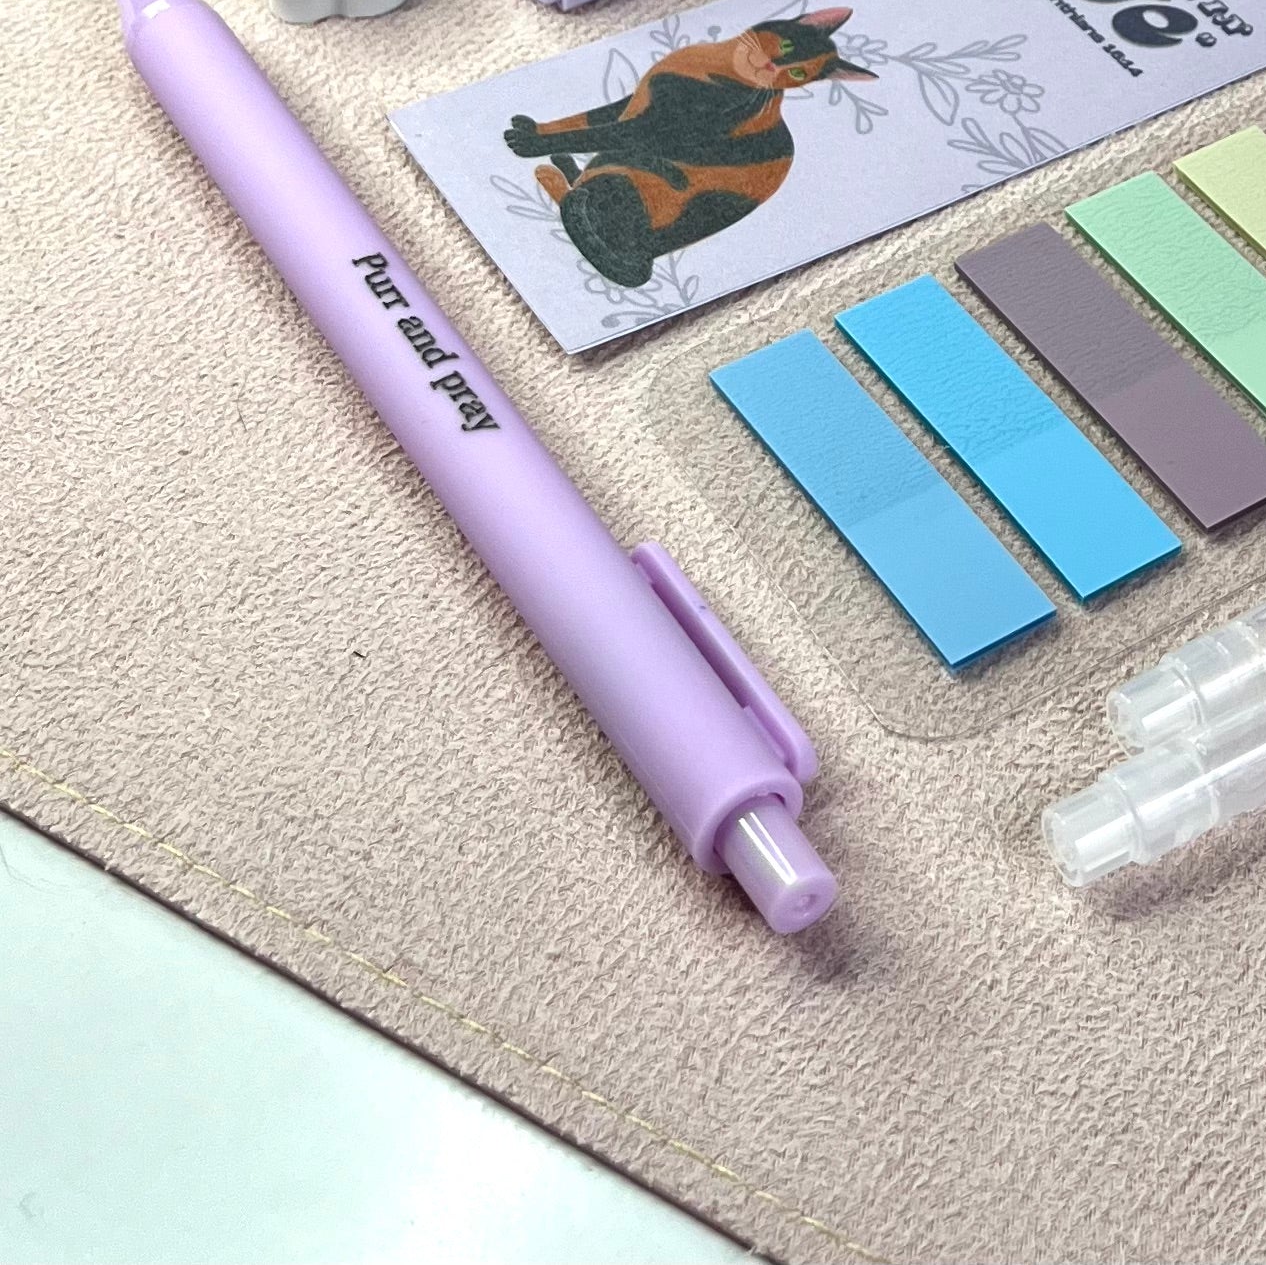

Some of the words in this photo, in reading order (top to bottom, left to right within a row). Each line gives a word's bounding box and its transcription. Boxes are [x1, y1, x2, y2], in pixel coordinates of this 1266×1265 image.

[1197, 0, 1253, 36] IN
[352, 251, 410, 310] Purr
[397, 315, 460, 369] and
[429, 370, 501, 432] pray
